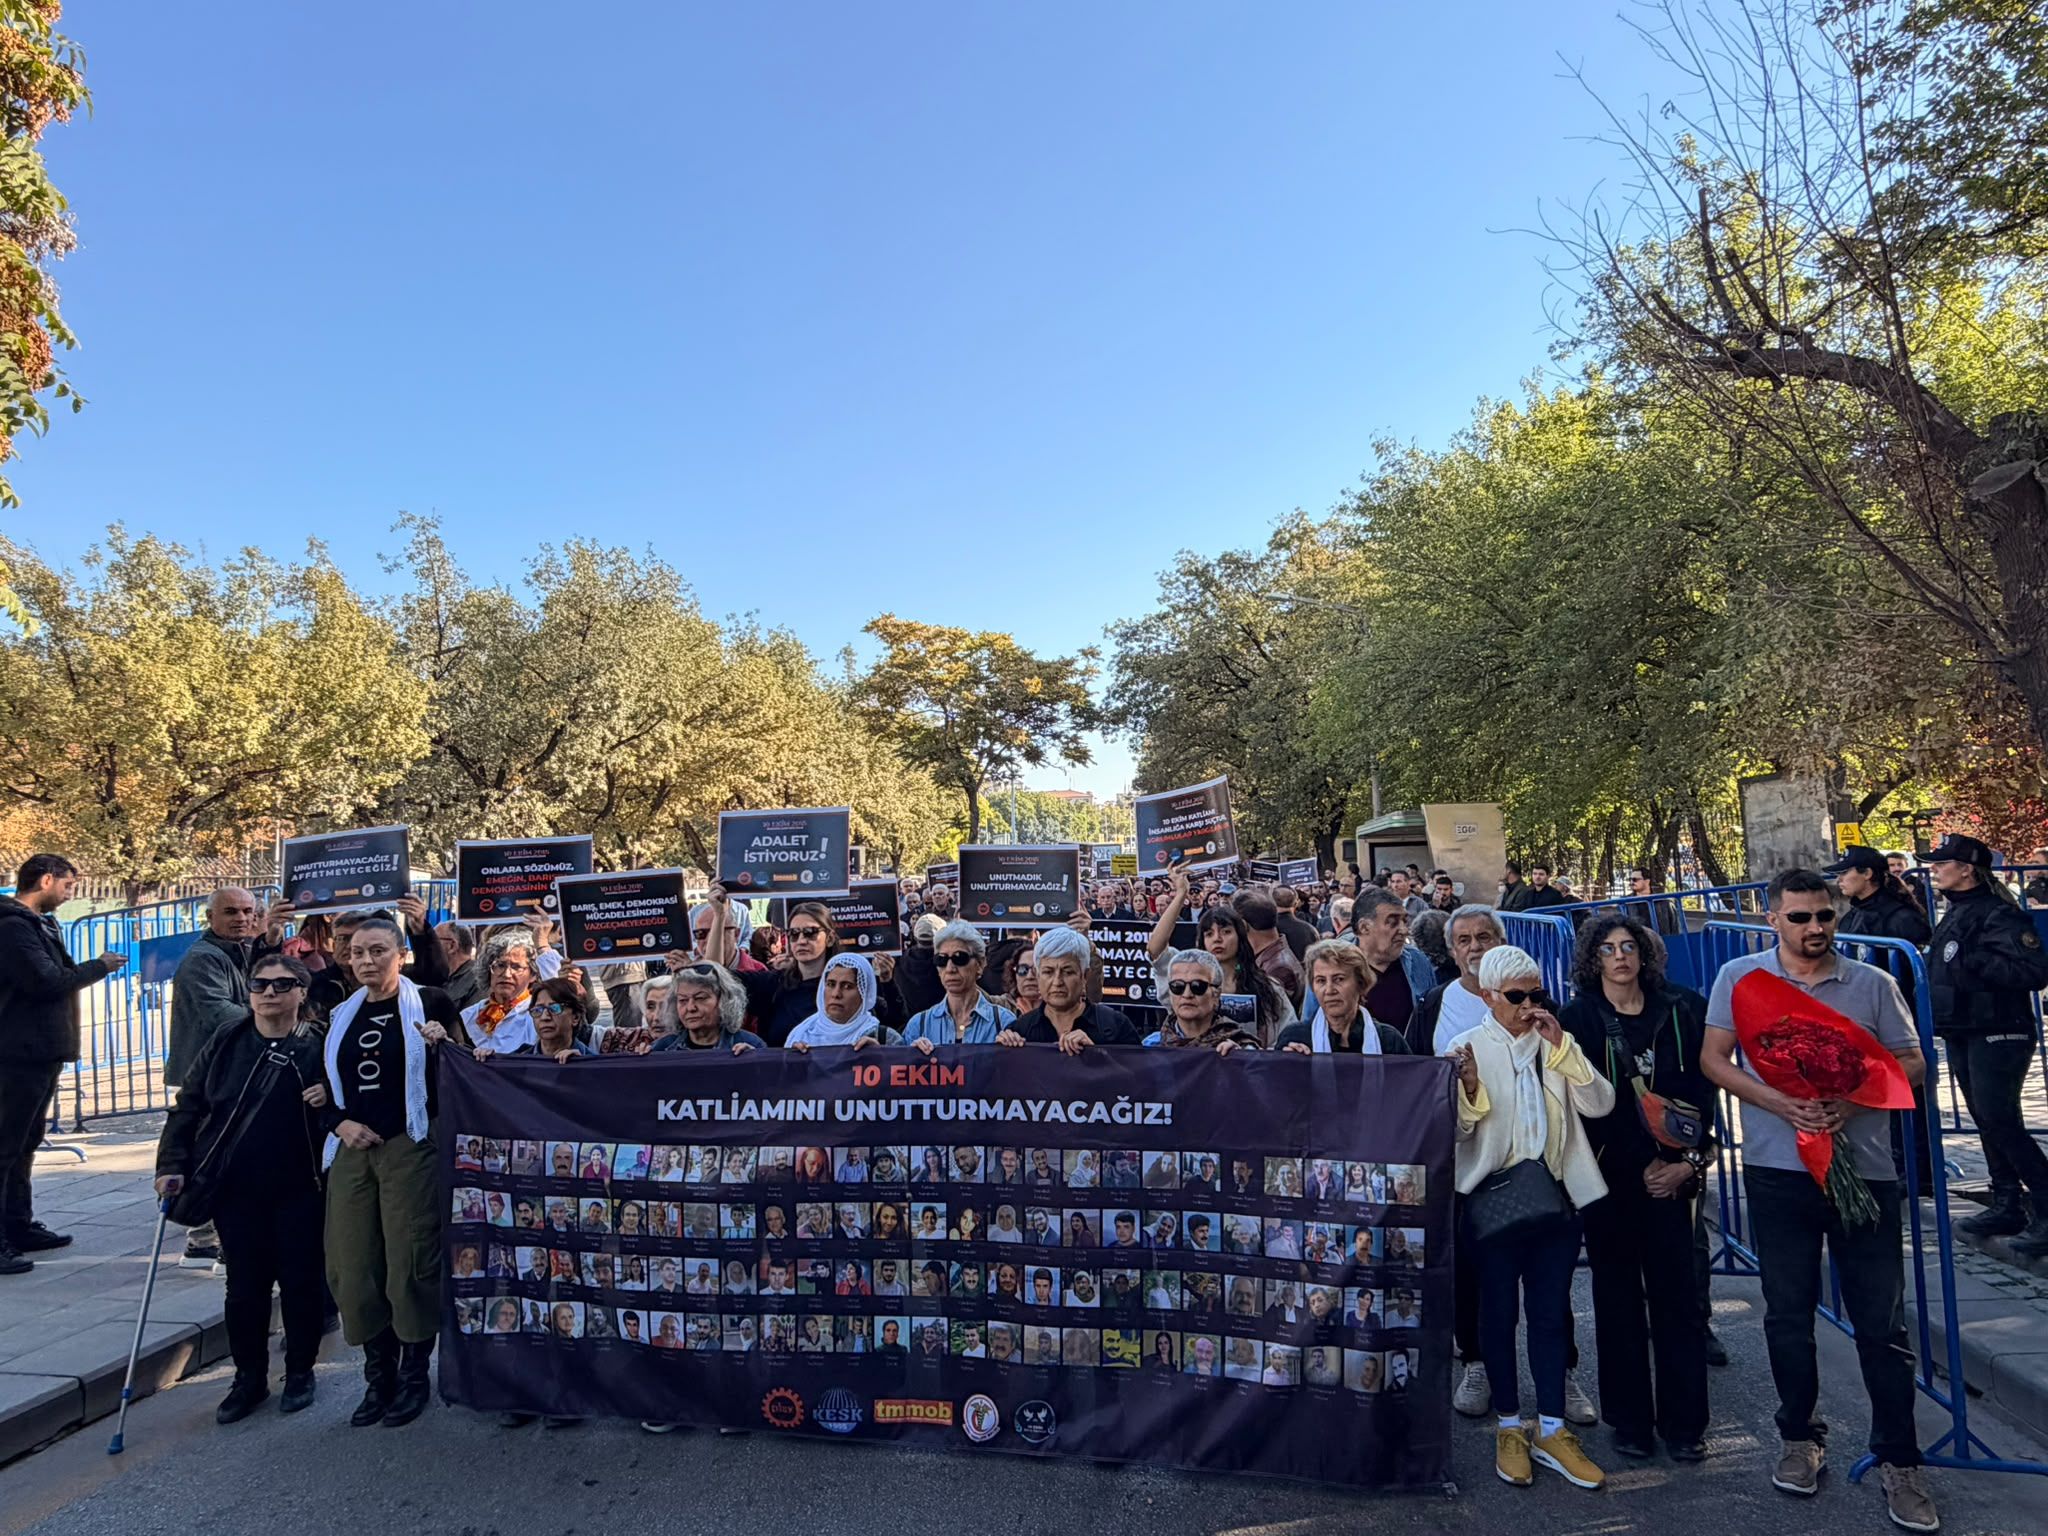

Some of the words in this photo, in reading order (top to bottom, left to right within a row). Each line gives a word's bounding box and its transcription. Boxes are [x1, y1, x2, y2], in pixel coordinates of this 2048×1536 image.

[751, 834, 809, 847] ADALET
[293, 854, 390, 872] UNUTTURMAYACAĞIZ
[481, 865, 522, 875] ONLARA
[524, 863, 574, 873] SÖZÜMÜZ,
[989, 873, 1042, 881] UNUTMADIK
[471, 882, 548, 894] DEMOKRASİNİN
[570, 903, 598, 912] BARIŞ,
[599, 901, 625, 910] EMEK,
[626, 895, 678, 908] DEMOKRASİ
[840, 904, 873, 913] KATLİAMI
[585, 907, 664, 920] MÜCADELESİNDEN
[358, 1013, 394, 1093] 10:04
[851, 1065, 881, 1087] 10
[890, 1056, 965, 1087] EKİM
[657, 1091, 825, 1121] KATLİAMINI
[834, 1095, 1173, 1125] UNUTTURMAYACAĞIZ!
[813, 1408, 863, 1421] KESK
[876, 1401, 953, 1420] tmmob
